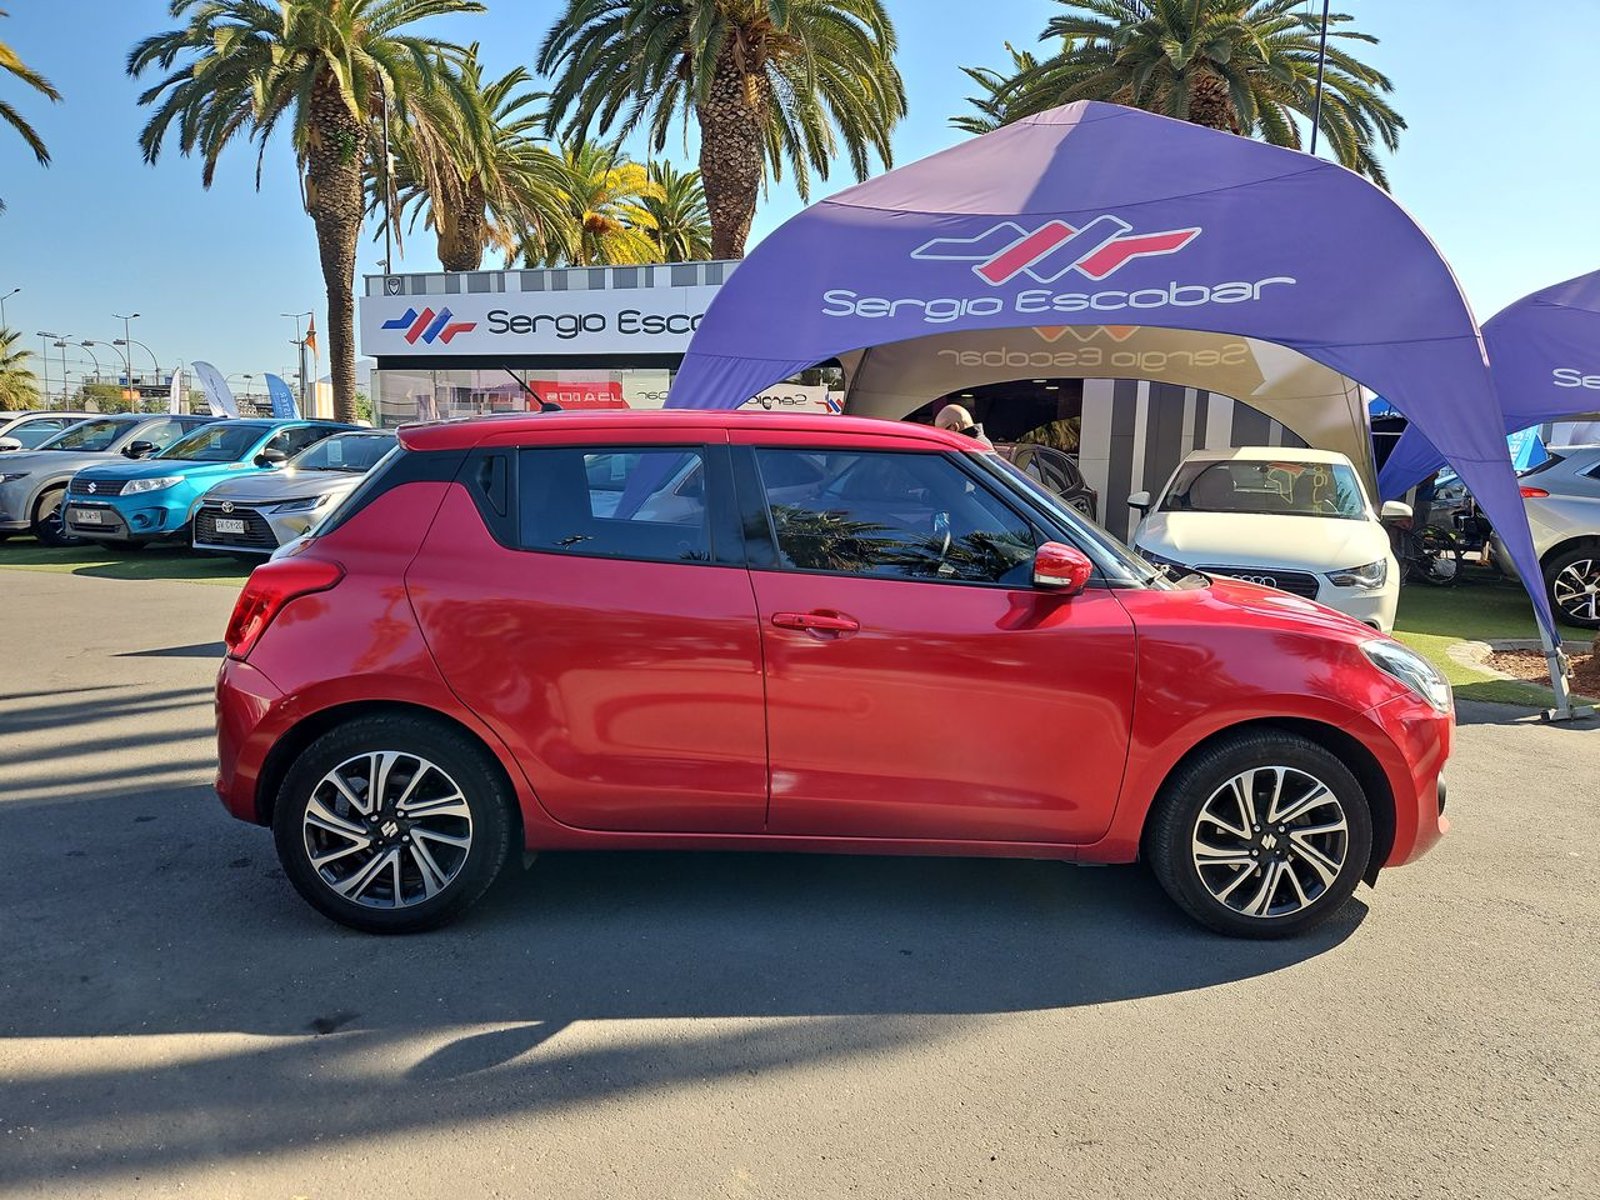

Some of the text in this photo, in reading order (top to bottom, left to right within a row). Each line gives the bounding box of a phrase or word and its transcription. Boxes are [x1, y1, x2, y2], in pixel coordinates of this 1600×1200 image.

[821, 276, 1296, 323] Sergio Escobar
[487, 309, 606, 339] Sergio
